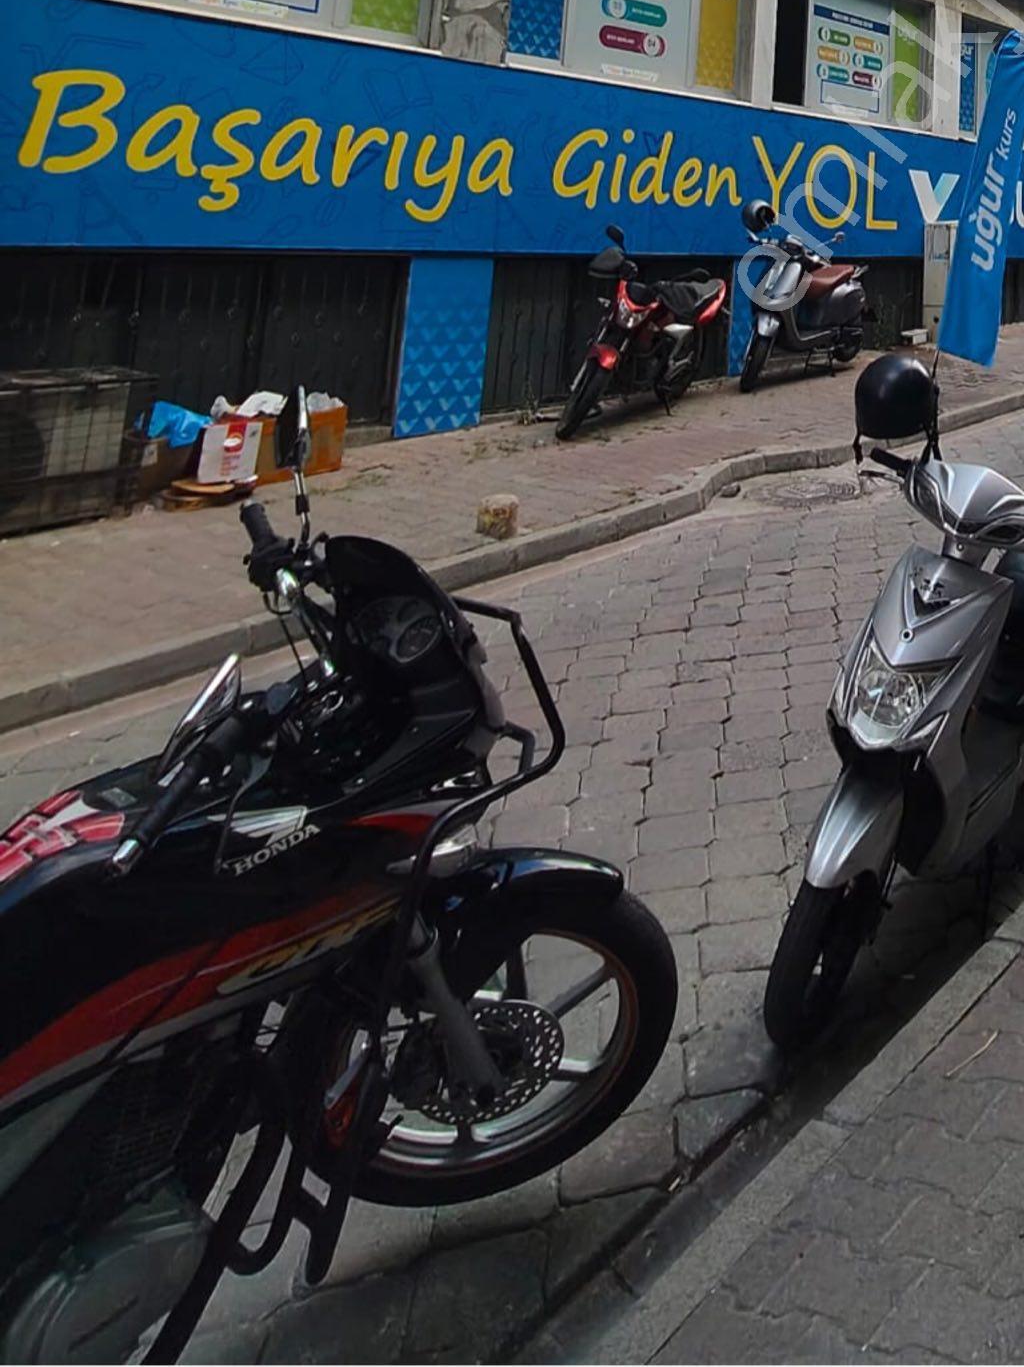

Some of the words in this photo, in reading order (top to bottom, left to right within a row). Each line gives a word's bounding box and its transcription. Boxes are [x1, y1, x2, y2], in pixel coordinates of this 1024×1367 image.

[18, 69, 514, 222] Başarıya
[552, 128, 742, 209] Giden
[752, 135, 898, 231] YOL
[970, 149, 1004, 272] uğur
[996, 107, 1017, 161] kurs
[233, 823, 321, 876] HONDA
